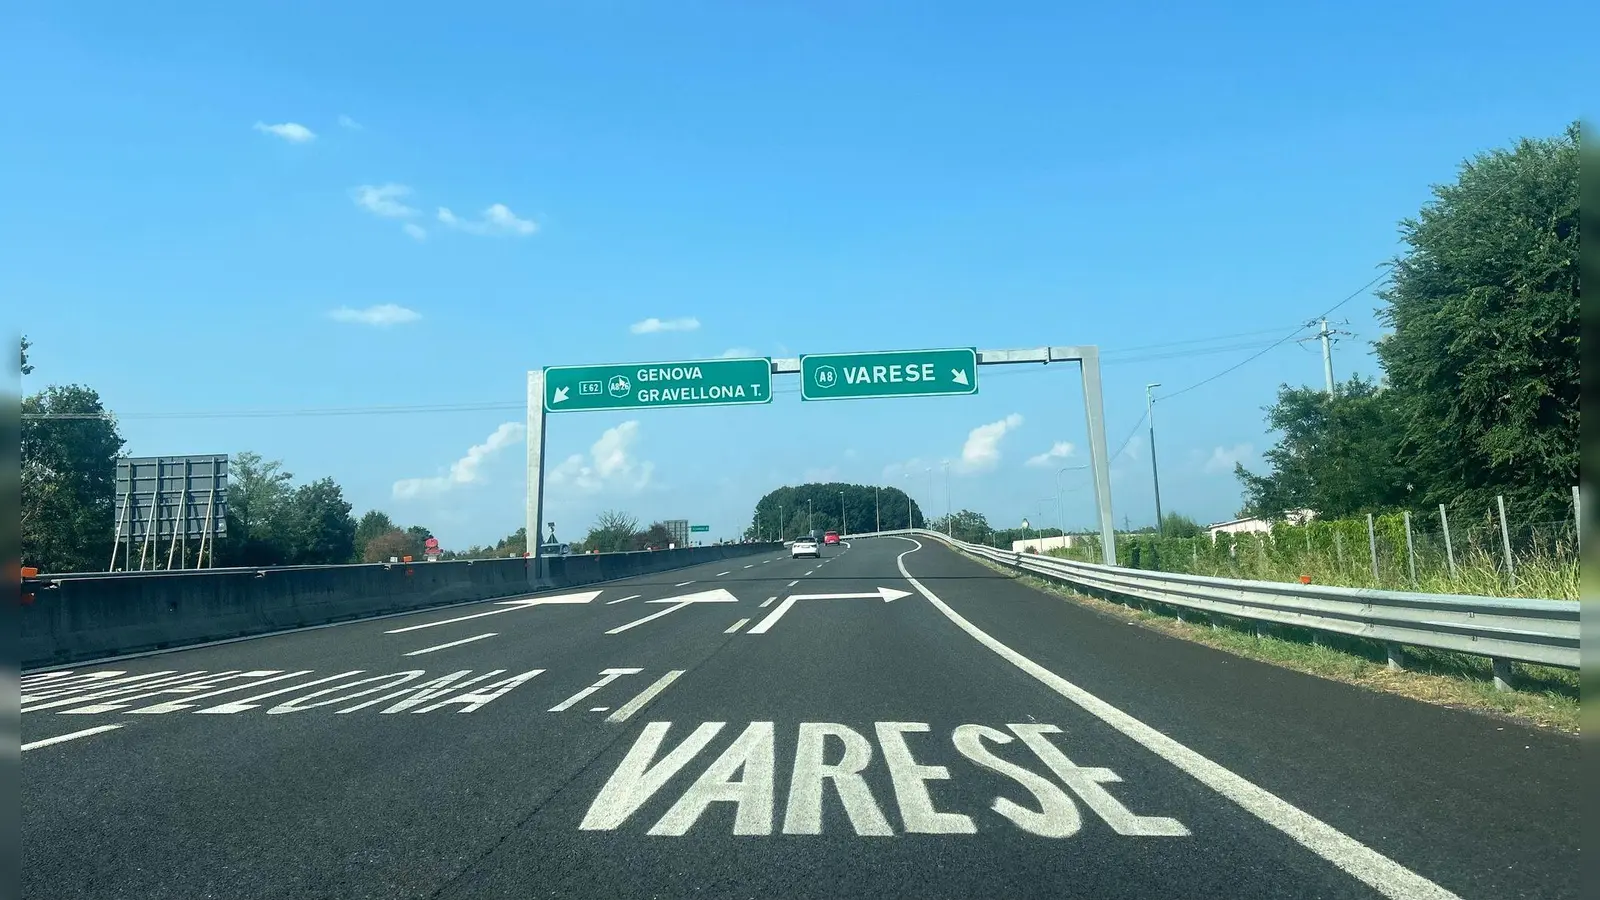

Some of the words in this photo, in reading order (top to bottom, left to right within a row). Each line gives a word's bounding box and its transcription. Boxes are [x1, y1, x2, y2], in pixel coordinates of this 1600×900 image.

[637, 366, 703, 382] GENOVA
[819, 371, 833, 383] A8
[843, 363, 936, 384] VARESE
[637, 384, 746, 402] GRAVELLONA
[750, 383, 762, 397] T.
[547, 667, 644, 713] T.
[578, 721, 1192, 838] VARESE
